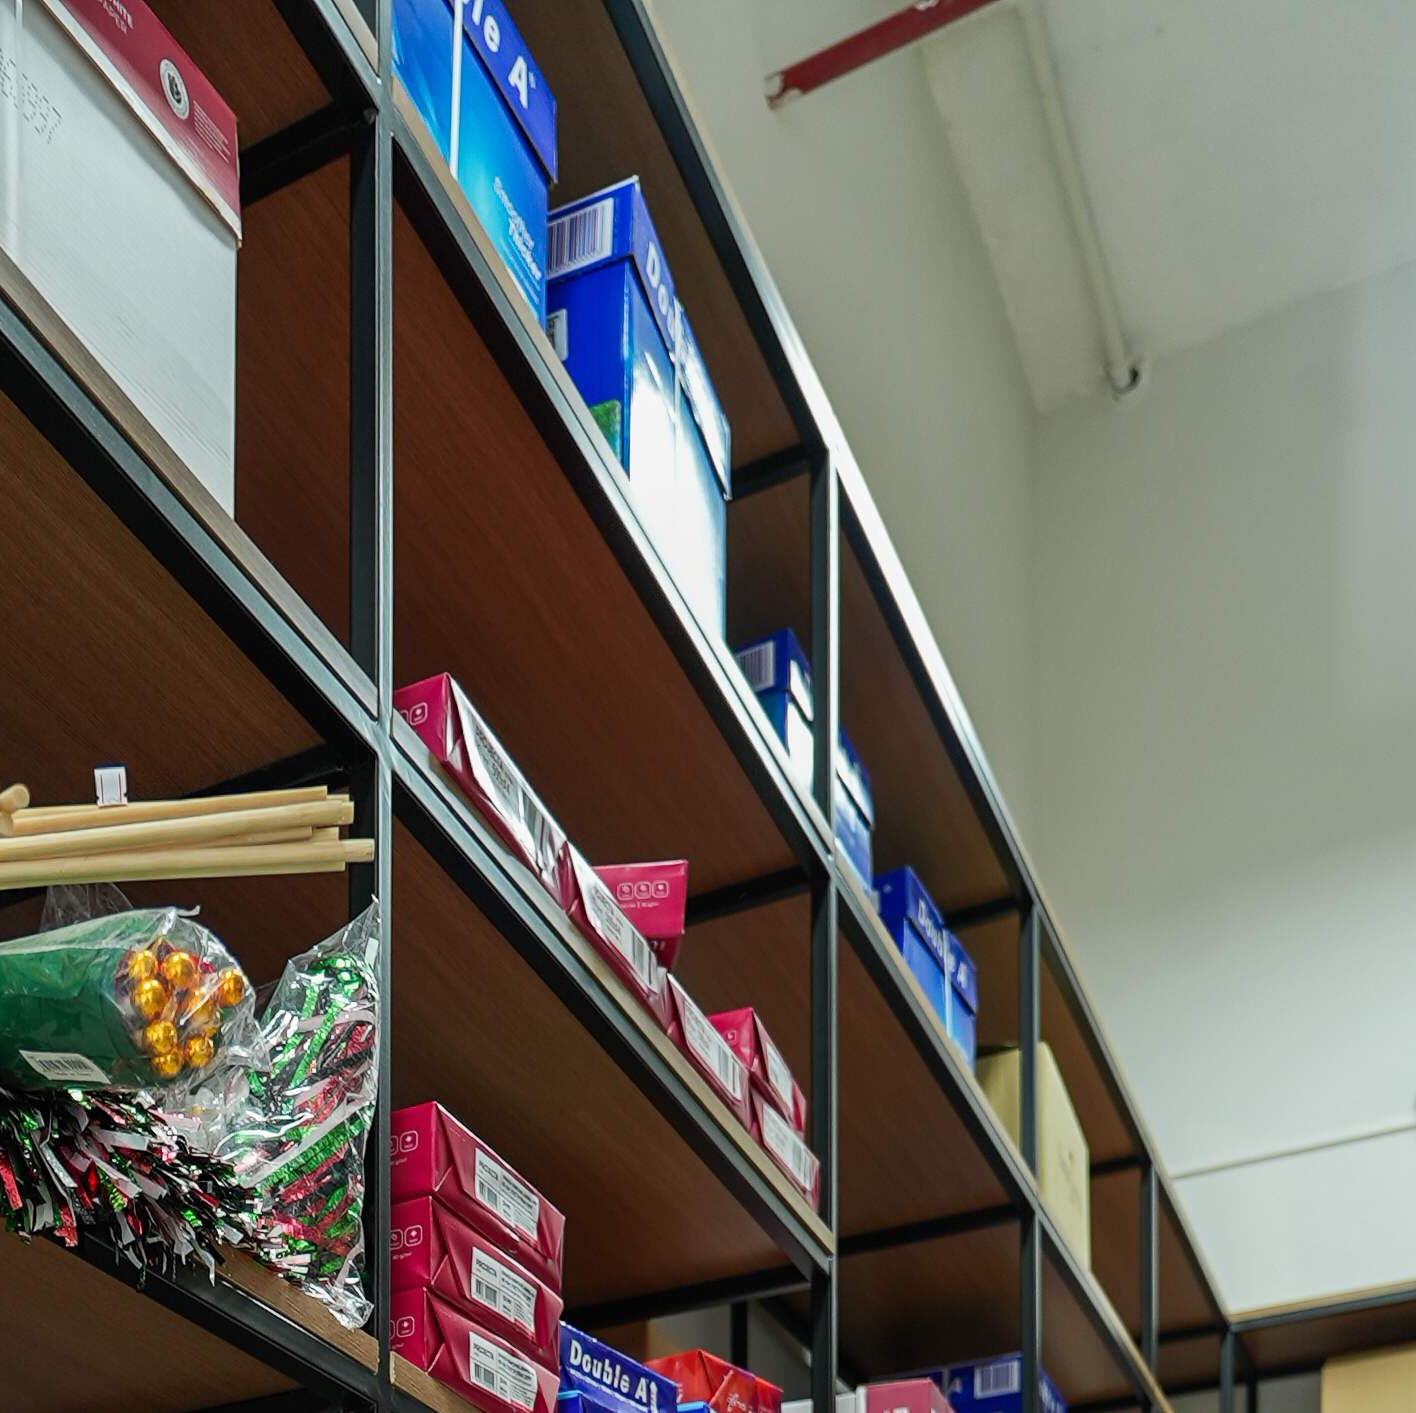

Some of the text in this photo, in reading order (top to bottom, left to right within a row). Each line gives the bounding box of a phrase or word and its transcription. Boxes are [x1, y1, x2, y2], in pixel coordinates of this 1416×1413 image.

[508, 57, 530, 107] A
[570, 1340, 648, 1403] Double A
